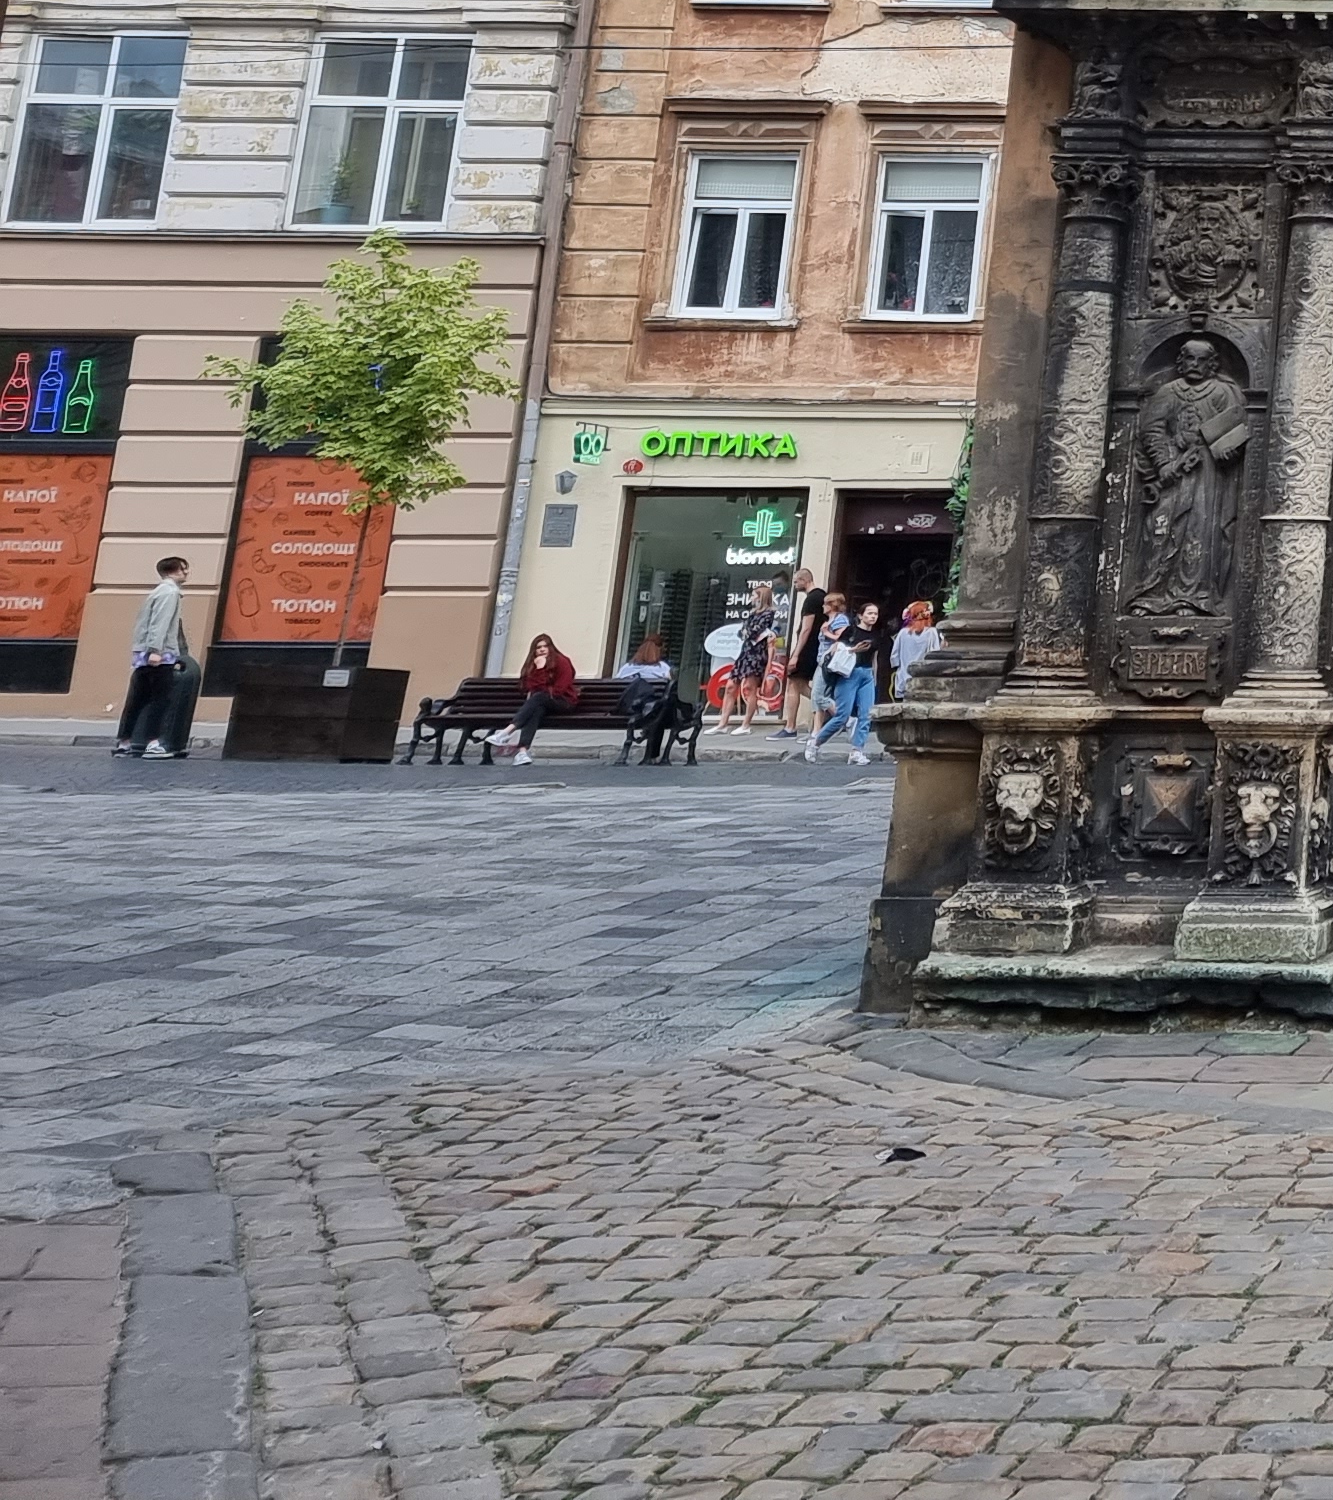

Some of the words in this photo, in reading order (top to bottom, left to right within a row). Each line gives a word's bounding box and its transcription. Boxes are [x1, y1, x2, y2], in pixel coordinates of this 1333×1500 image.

[640, 430, 798, 459] ОПТИКА
[3, 487, 58, 503] НАПОЇ
[293, 488, 350, 506] НАПОЇ
[725, 545, 796, 565] biomed
[271, 599, 336, 613] ТЮТЮН
[725, 592, 790, 606] ЗНИКА
